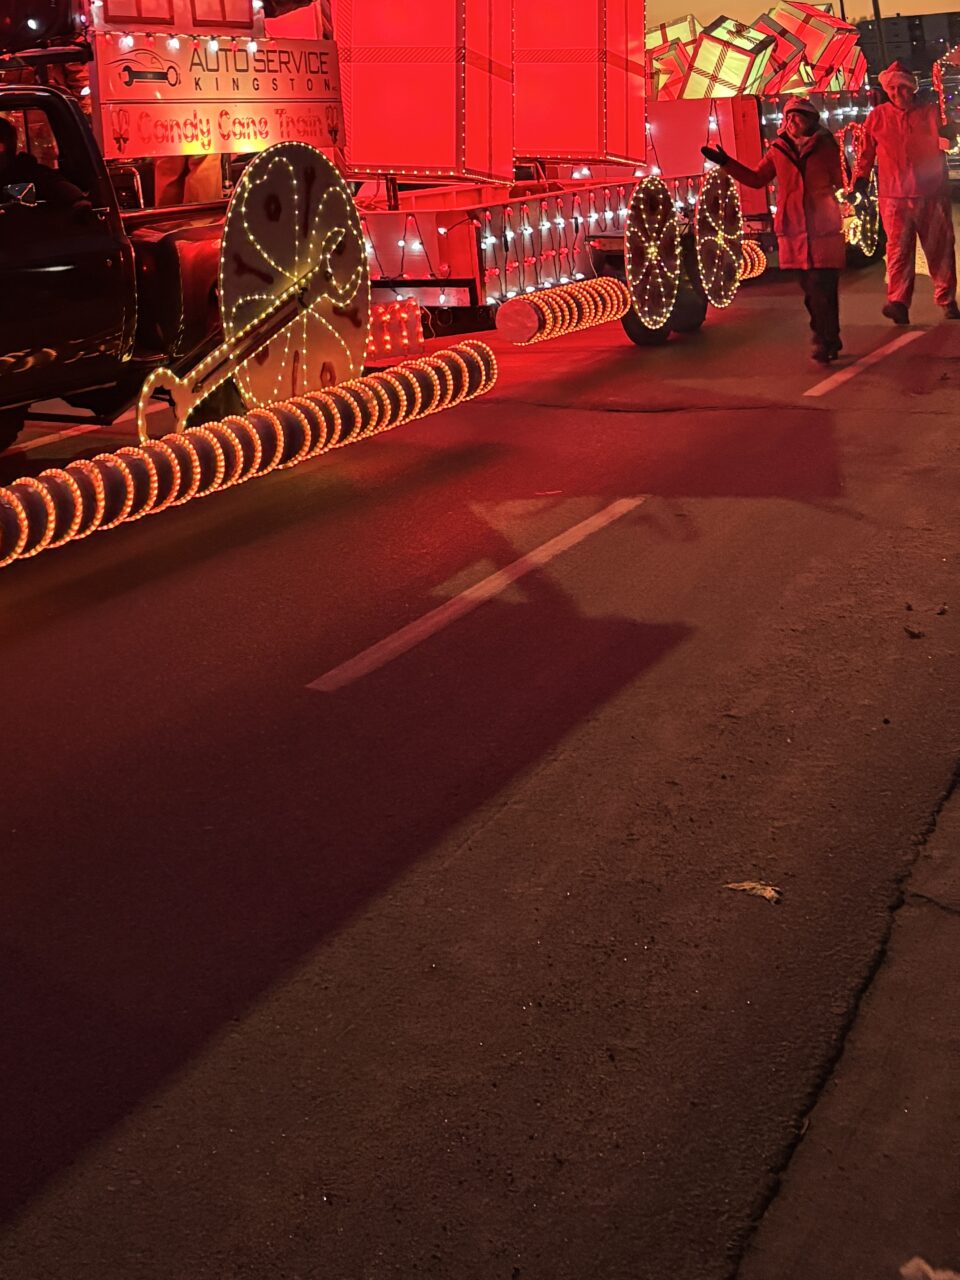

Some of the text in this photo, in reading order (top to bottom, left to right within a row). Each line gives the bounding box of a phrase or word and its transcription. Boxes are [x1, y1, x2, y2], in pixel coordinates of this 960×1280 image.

[190, 48, 329, 74] AUTO SERVICE
[194, 77, 331, 91] KINGSTON
[138, 108, 322, 150] Candy Cane Train
